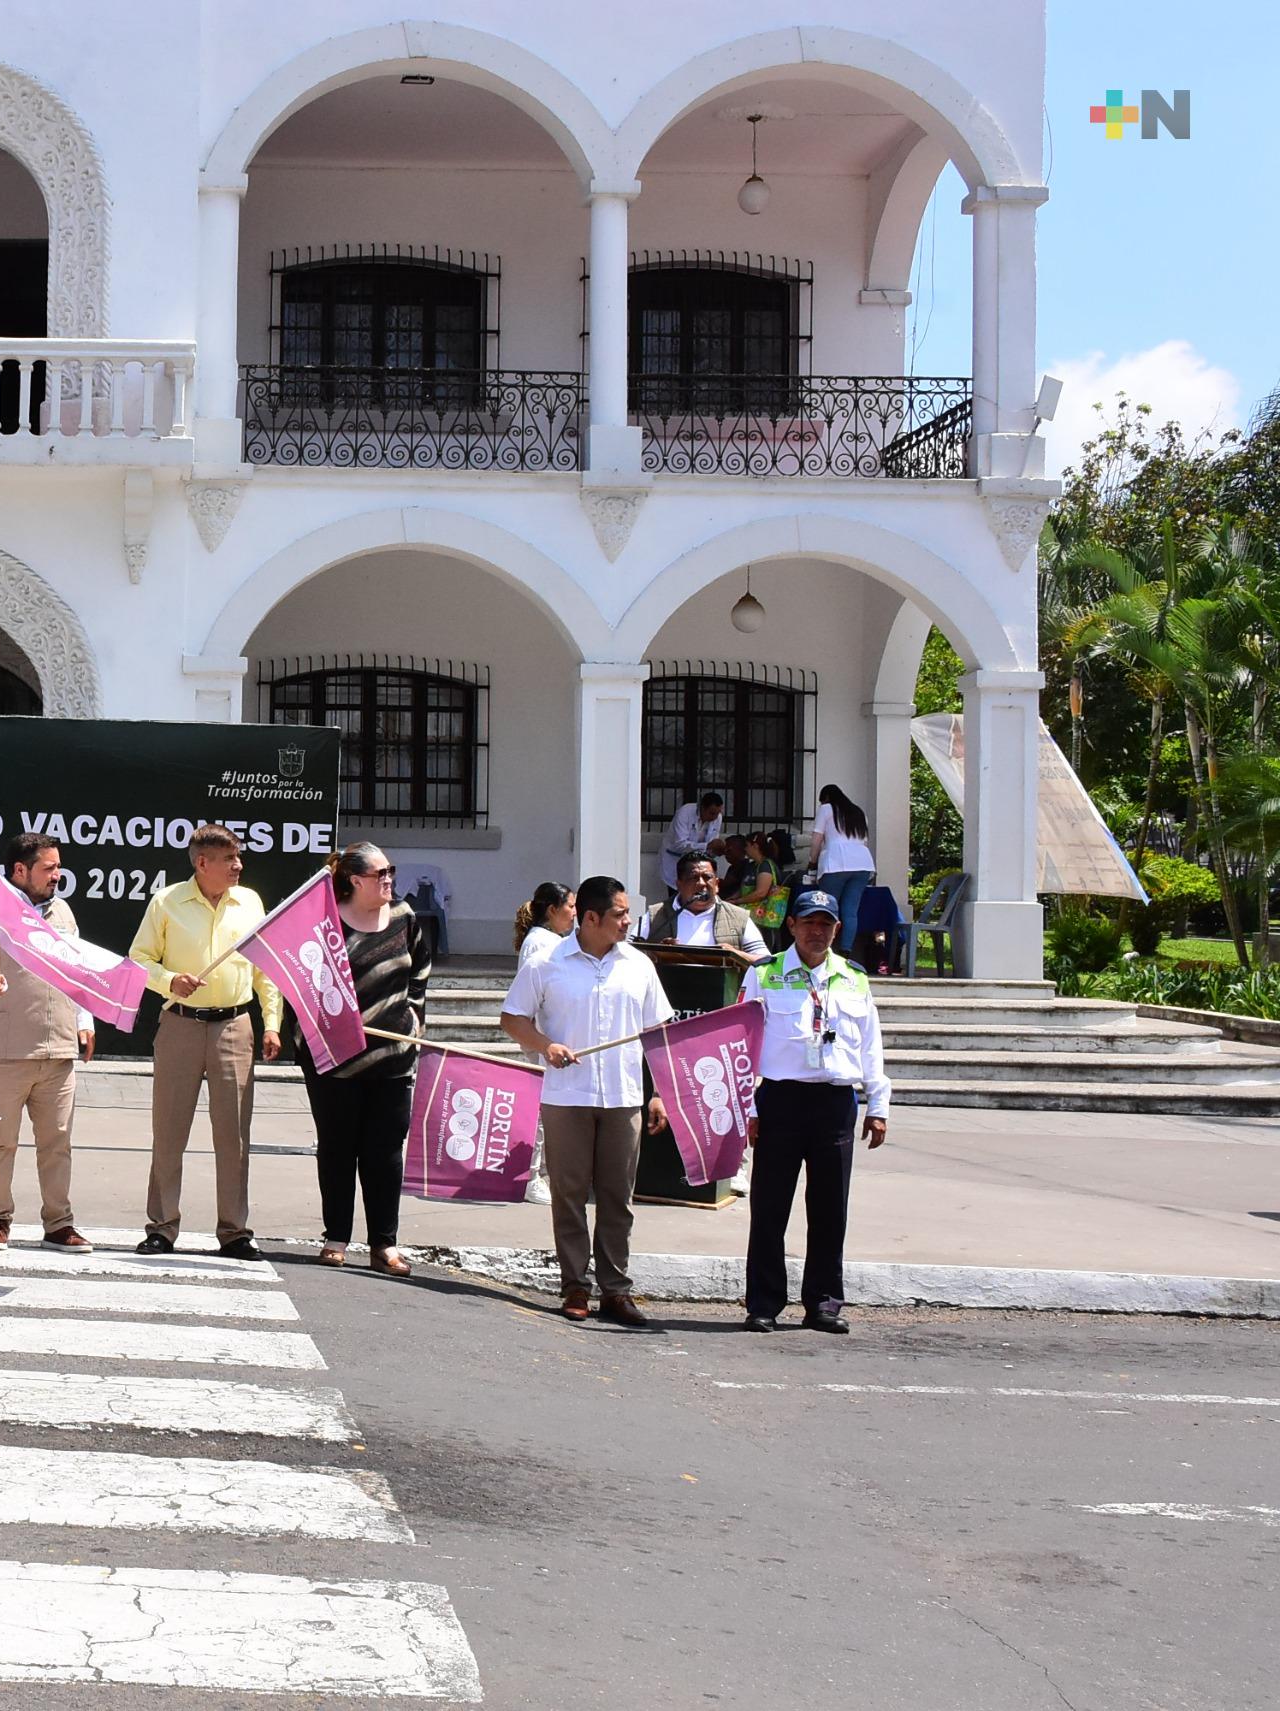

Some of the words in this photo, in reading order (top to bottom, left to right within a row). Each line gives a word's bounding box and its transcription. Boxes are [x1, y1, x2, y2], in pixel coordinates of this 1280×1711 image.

[207, 784, 323, 801] Transformación
[221, 770, 278, 785] #Juntos
[278, 780, 294, 789] por
[295, 779, 305, 788] la
[20, 811, 274, 853] VACACIOES
[283, 822, 333, 854] DE
[86, 868, 167, 901] 2024
[485, 1088, 516, 1175] FORTÍN
